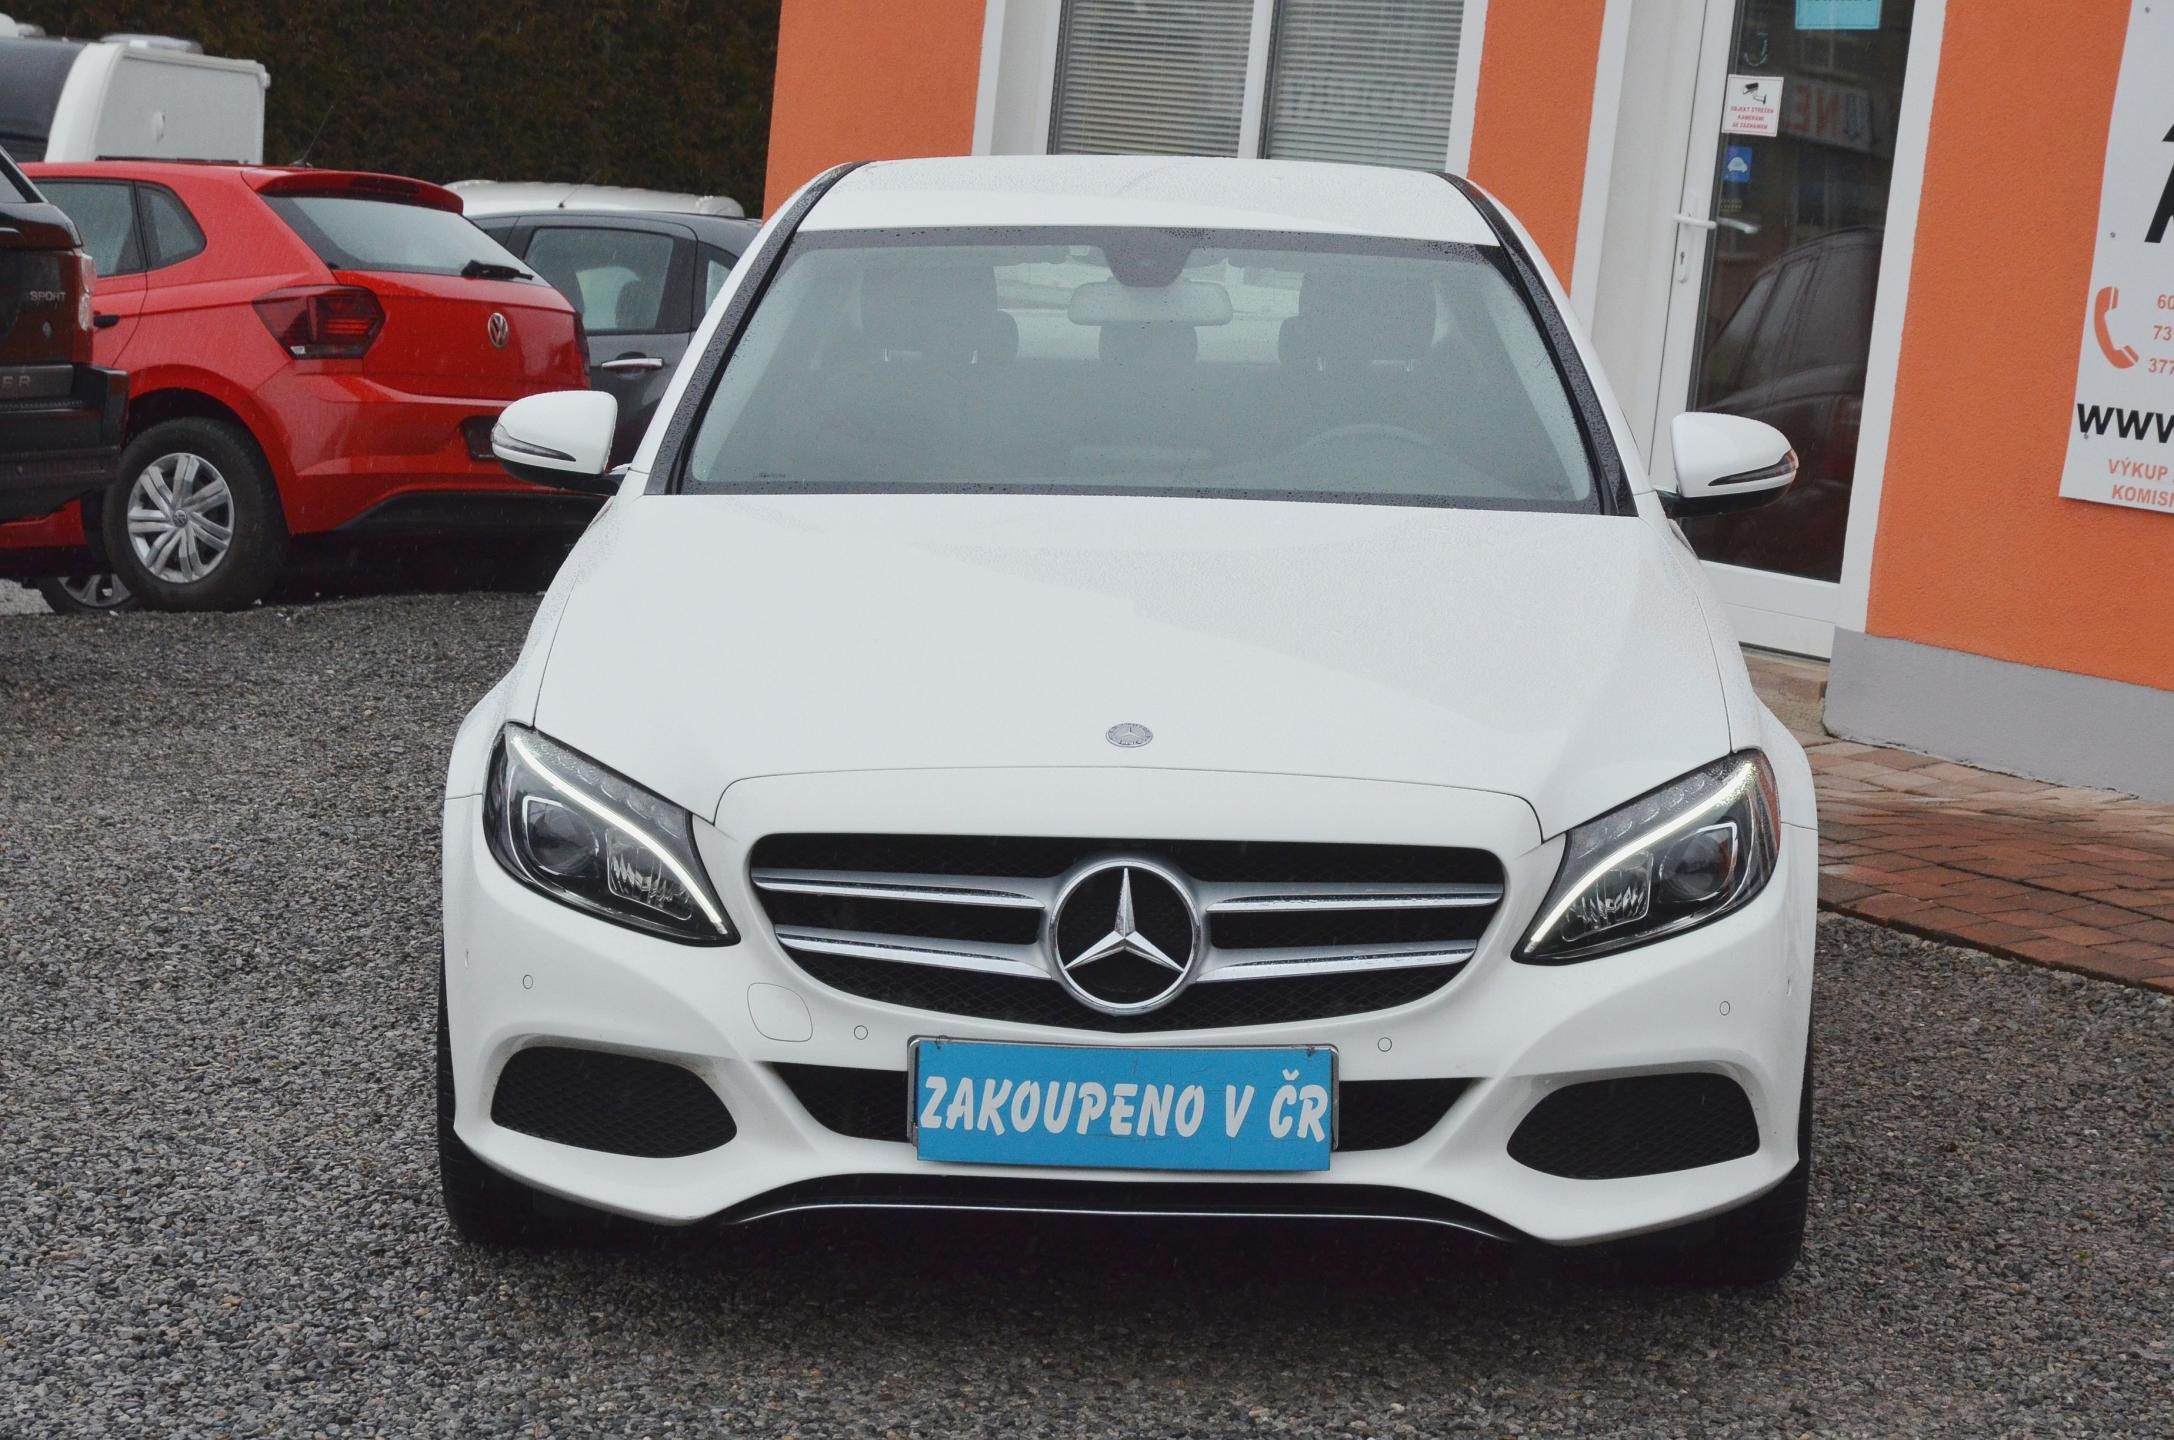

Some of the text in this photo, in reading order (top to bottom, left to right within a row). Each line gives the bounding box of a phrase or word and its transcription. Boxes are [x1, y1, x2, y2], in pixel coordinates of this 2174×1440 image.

[30, 291, 66, 301] SPORT
[2108, 457, 2169, 480] VÝKUP
[920, 1069, 1328, 1142] ZAKOUPENO V ČR
